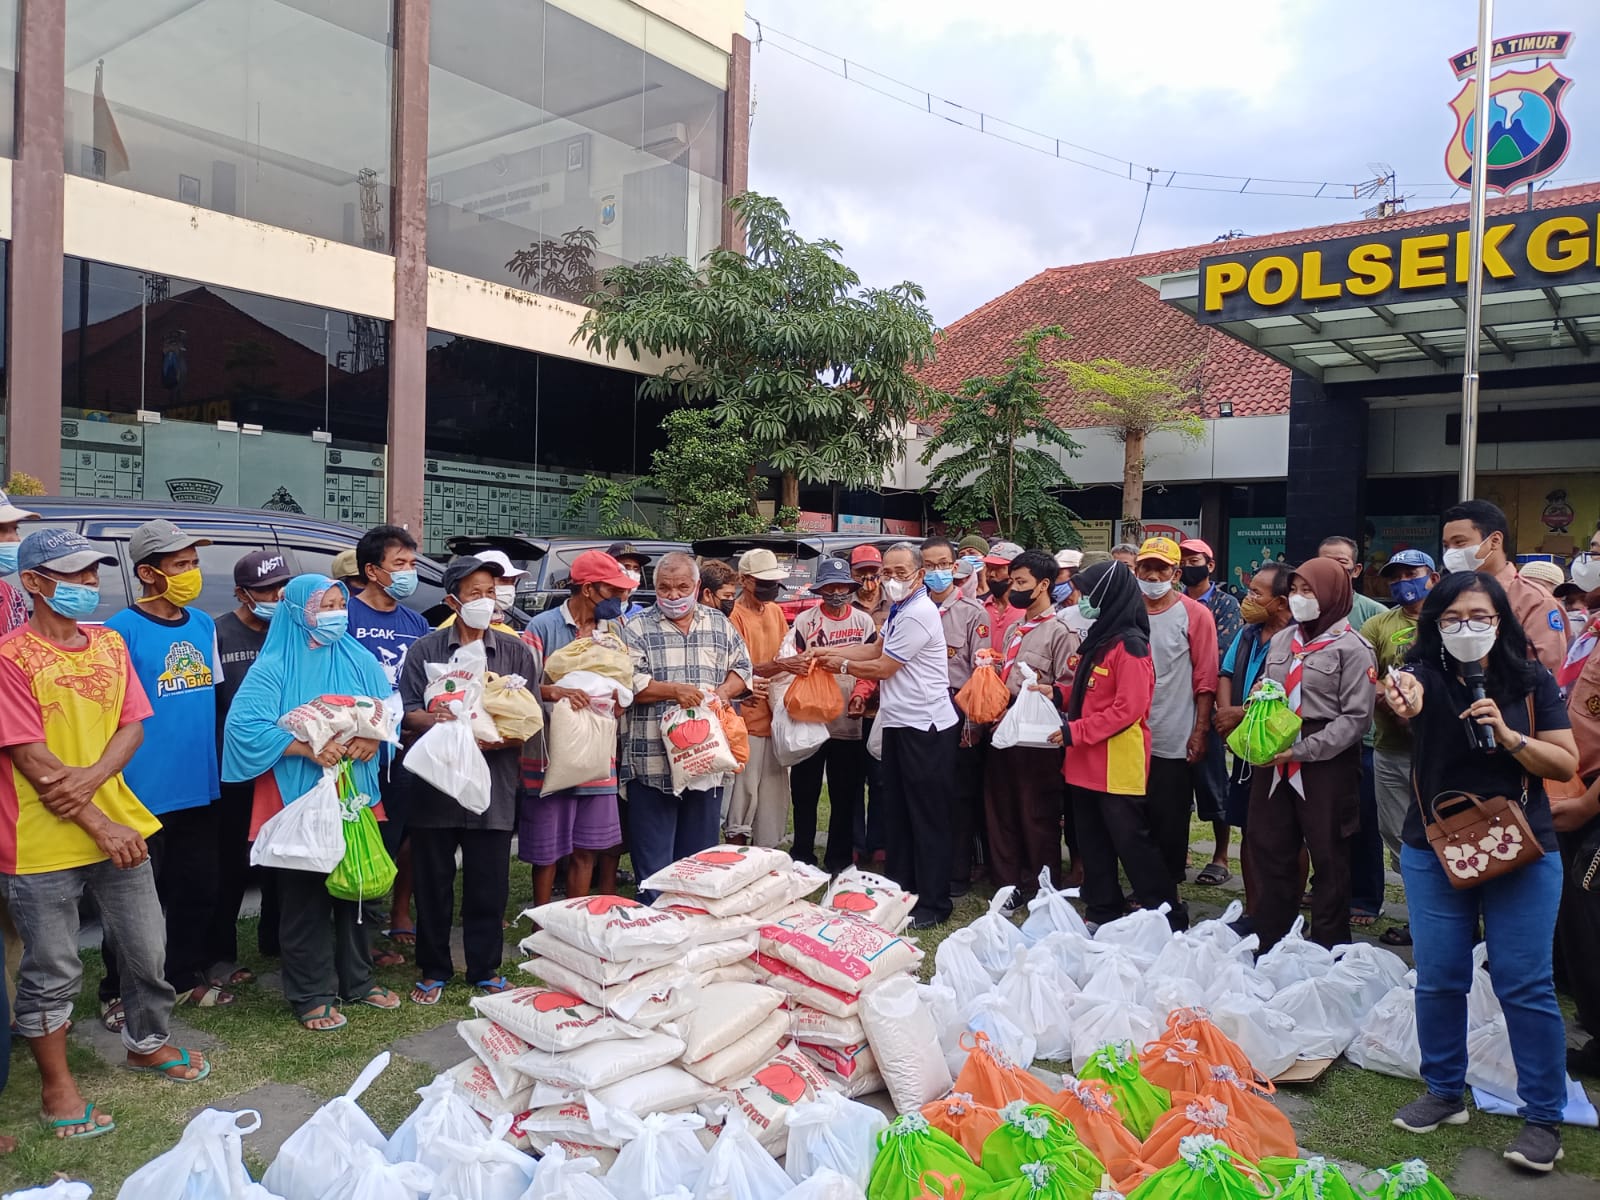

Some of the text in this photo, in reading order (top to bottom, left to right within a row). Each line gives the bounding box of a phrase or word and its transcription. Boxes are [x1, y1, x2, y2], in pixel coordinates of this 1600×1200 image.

[1462, 35, 1559, 67] JAA TIMUR
[1204, 211, 1600, 312] POLSEK G
[257, 554, 285, 578] NASTY
[673, 750, 693, 765] APEL
[693, 740, 720, 755] MANIS
